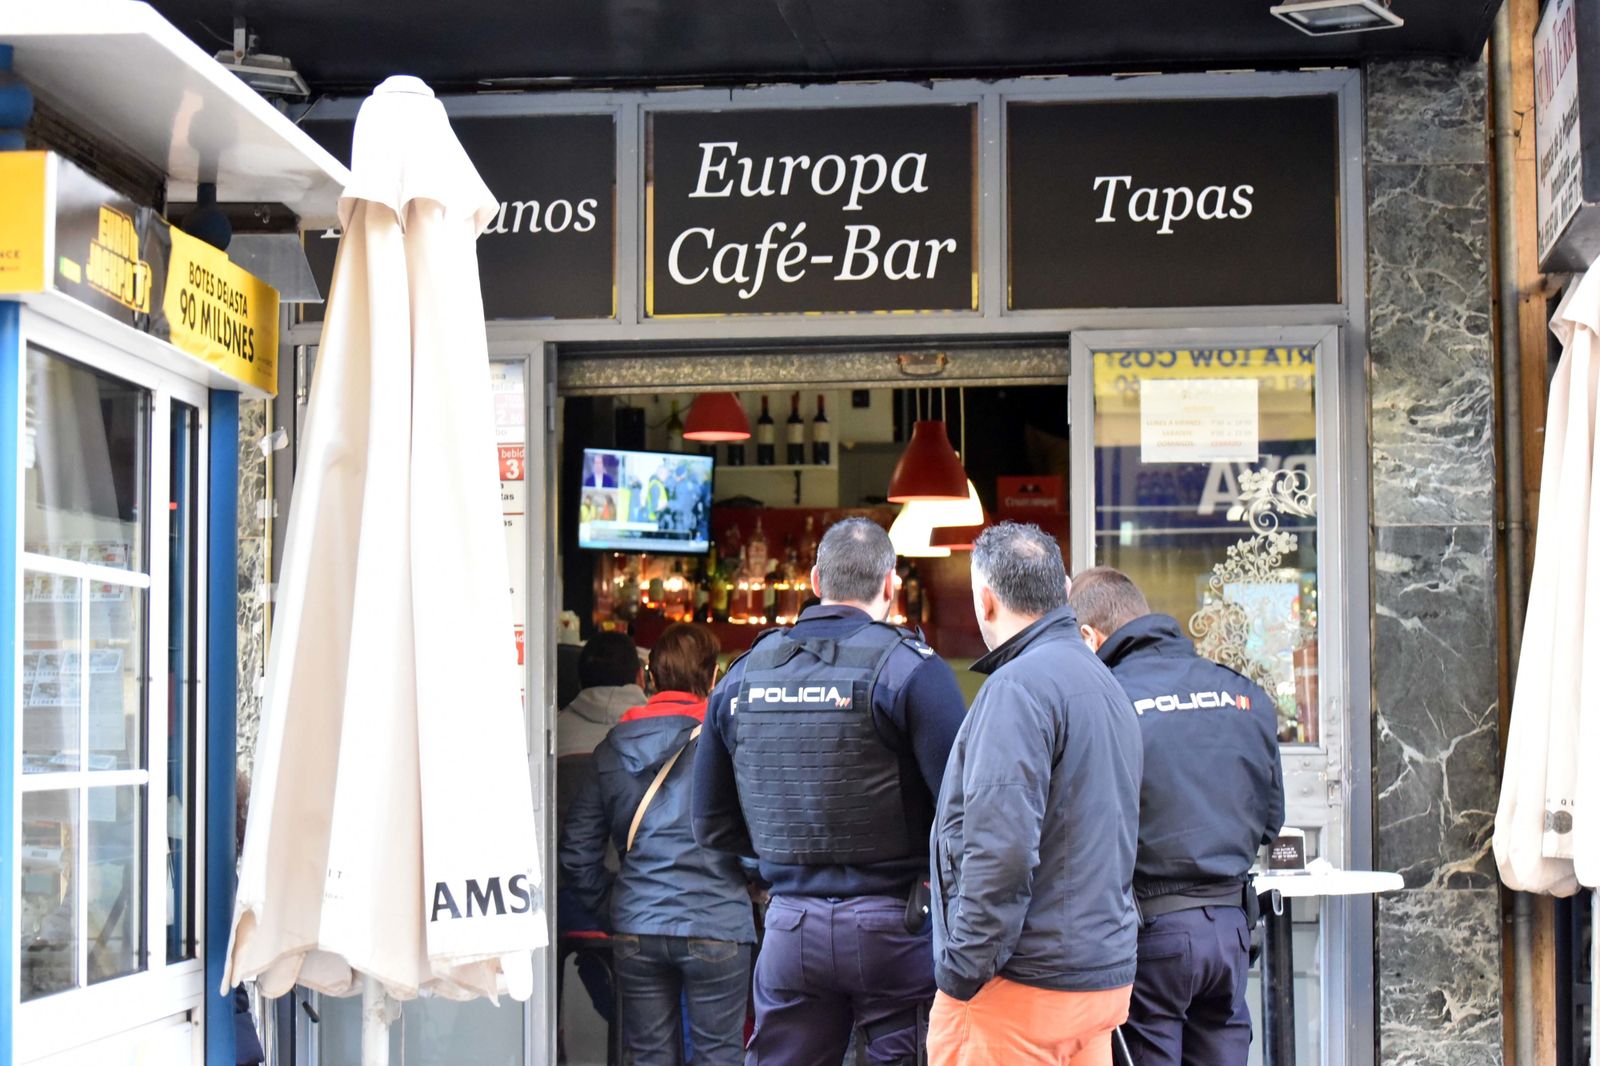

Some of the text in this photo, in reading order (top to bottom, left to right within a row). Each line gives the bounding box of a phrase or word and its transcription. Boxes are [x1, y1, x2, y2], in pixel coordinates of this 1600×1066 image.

[688, 141, 928, 211] Europa
[1093, 175, 1254, 234] Tapas
[189, 261, 215, 296] BOTES
[668, 222, 957, 299] Café-Bar
[180, 288, 196, 331] 90
[748, 686, 841, 703] POLICIA
[1133, 691, 1236, 715] POLICIA
[431, 874, 531, 922] AMS
